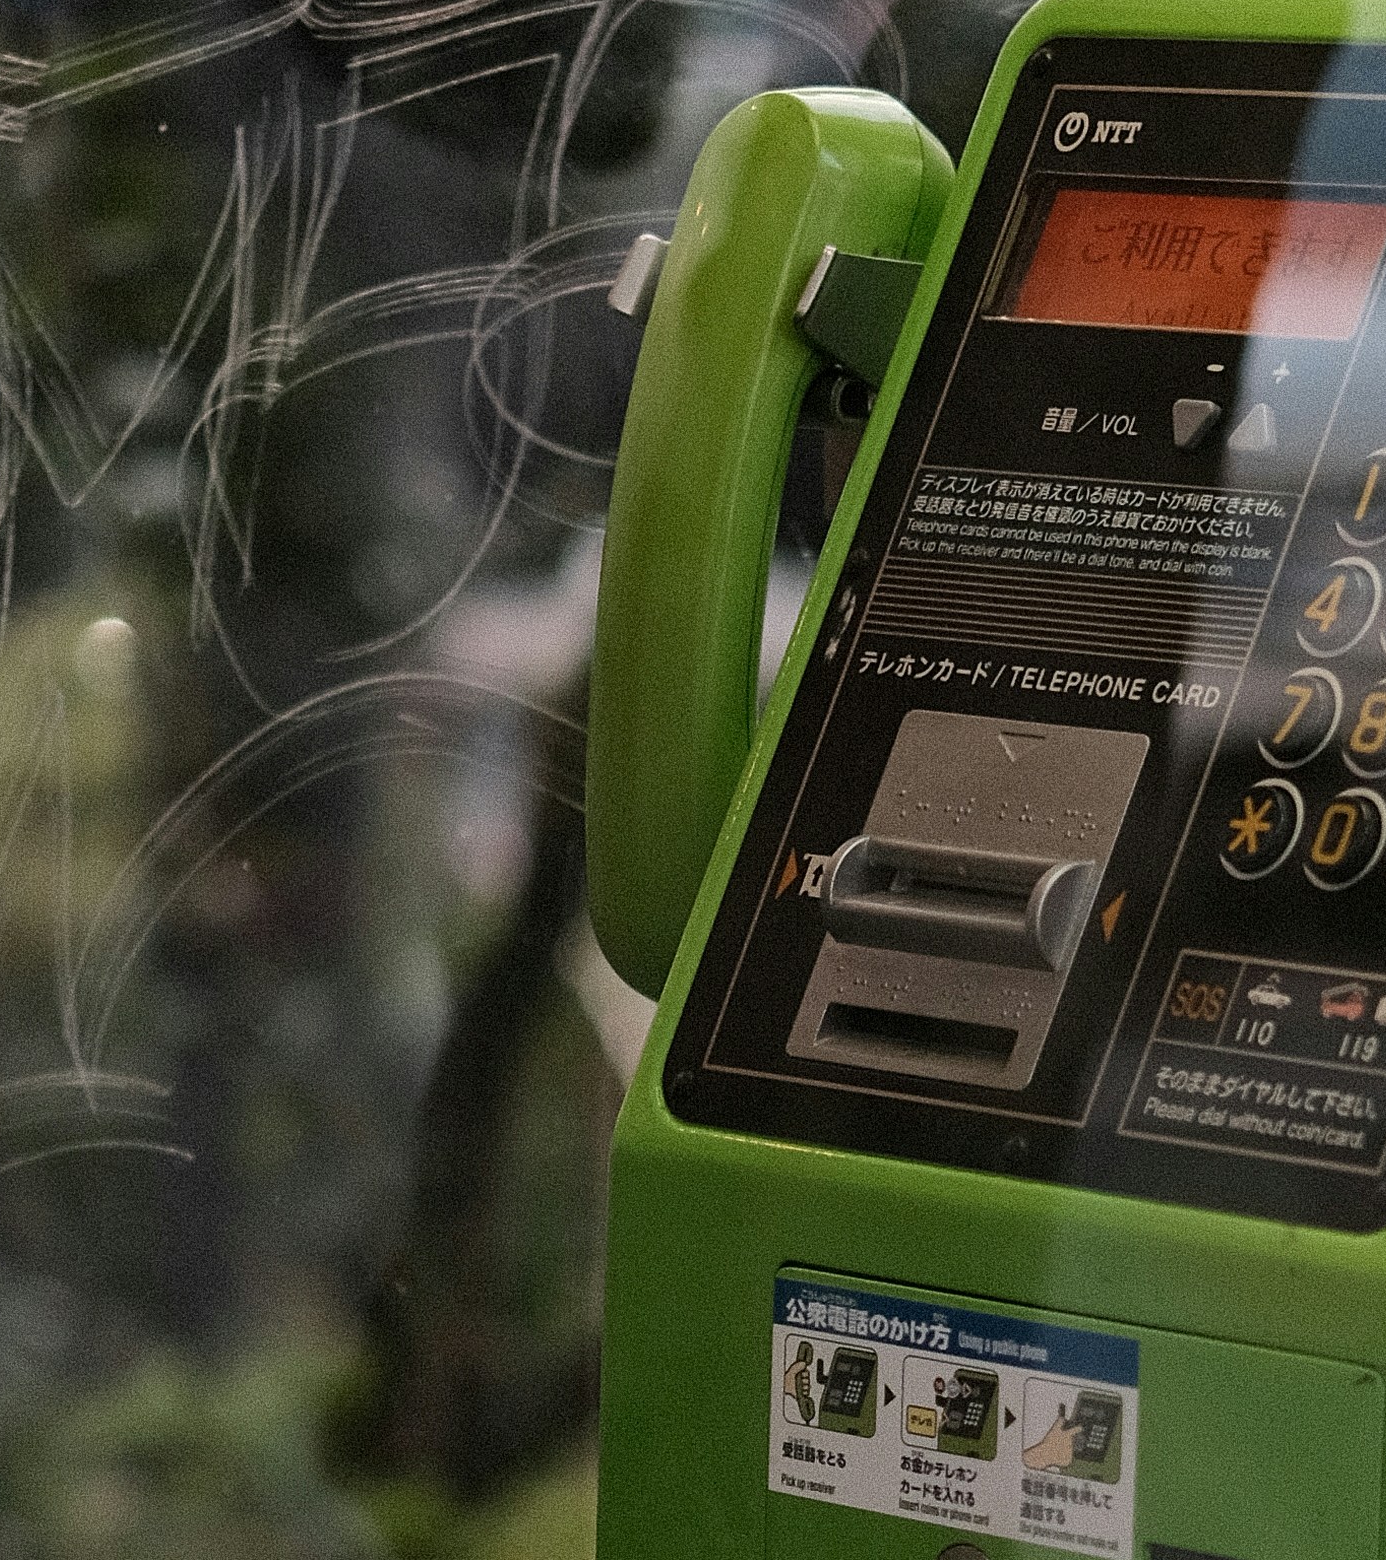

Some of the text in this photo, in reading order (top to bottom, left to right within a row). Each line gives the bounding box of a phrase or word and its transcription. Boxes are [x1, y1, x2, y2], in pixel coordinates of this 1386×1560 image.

[1090, 120, 1143, 144] NTT
[1353, 464, 1380, 523] 1
[897, 536, 920, 552] Pick
[921, 540, 936, 554] up
[937, 539, 955, 554] the
[956, 542, 1001, 558] receiver
[1001, 545, 1023, 561] and
[1061, 549, 1078, 565] be
[1078, 554, 1086, 565] a
[1087, 552, 1109, 567] dial
[1138, 557, 1160, 571] and
[1162, 558, 1183, 573] dial
[1183, 561, 1206, 575] with
[906, 517, 959, 536] Telephone
[959, 523, 988, 538] cards
[990, 526, 1026, 540] cannot
[1028, 528, 1044, 543] be
[1044, 530, 1070, 544] used
[1072, 532, 1083, 545] in
[1083, 533, 1102, 547] this
[1103, 535, 1138, 550] phone
[1139, 537, 1170, 553] when
[1170, 539, 1188, 555] the
[1190, 542, 1229, 559] display
[1229, 544, 1240, 557] is
[1303, 575, 1348, 633] 4
[858, 649, 992, 686] テレホンカード
[1010, 664, 1147, 702] TELEPHONE
[1151, 680, 1222, 709] CARD
[1272, 684, 1313, 746] 7
[1311, 802, 1359, 866] 0
[1170, 981, 1226, 1023] SOS
[1234, 1018, 1277, 1047] 110
[1337, 1033, 1380, 1063] 119
[1143, 1095, 1195, 1123] Please
[1197, 1105, 1229, 1127] dial
[1229, 1111, 1286, 1137] without
[785, 1297, 952, 1351] 公衆電話のかけ方
[899, 1479, 976, 1507] カードを入れる
